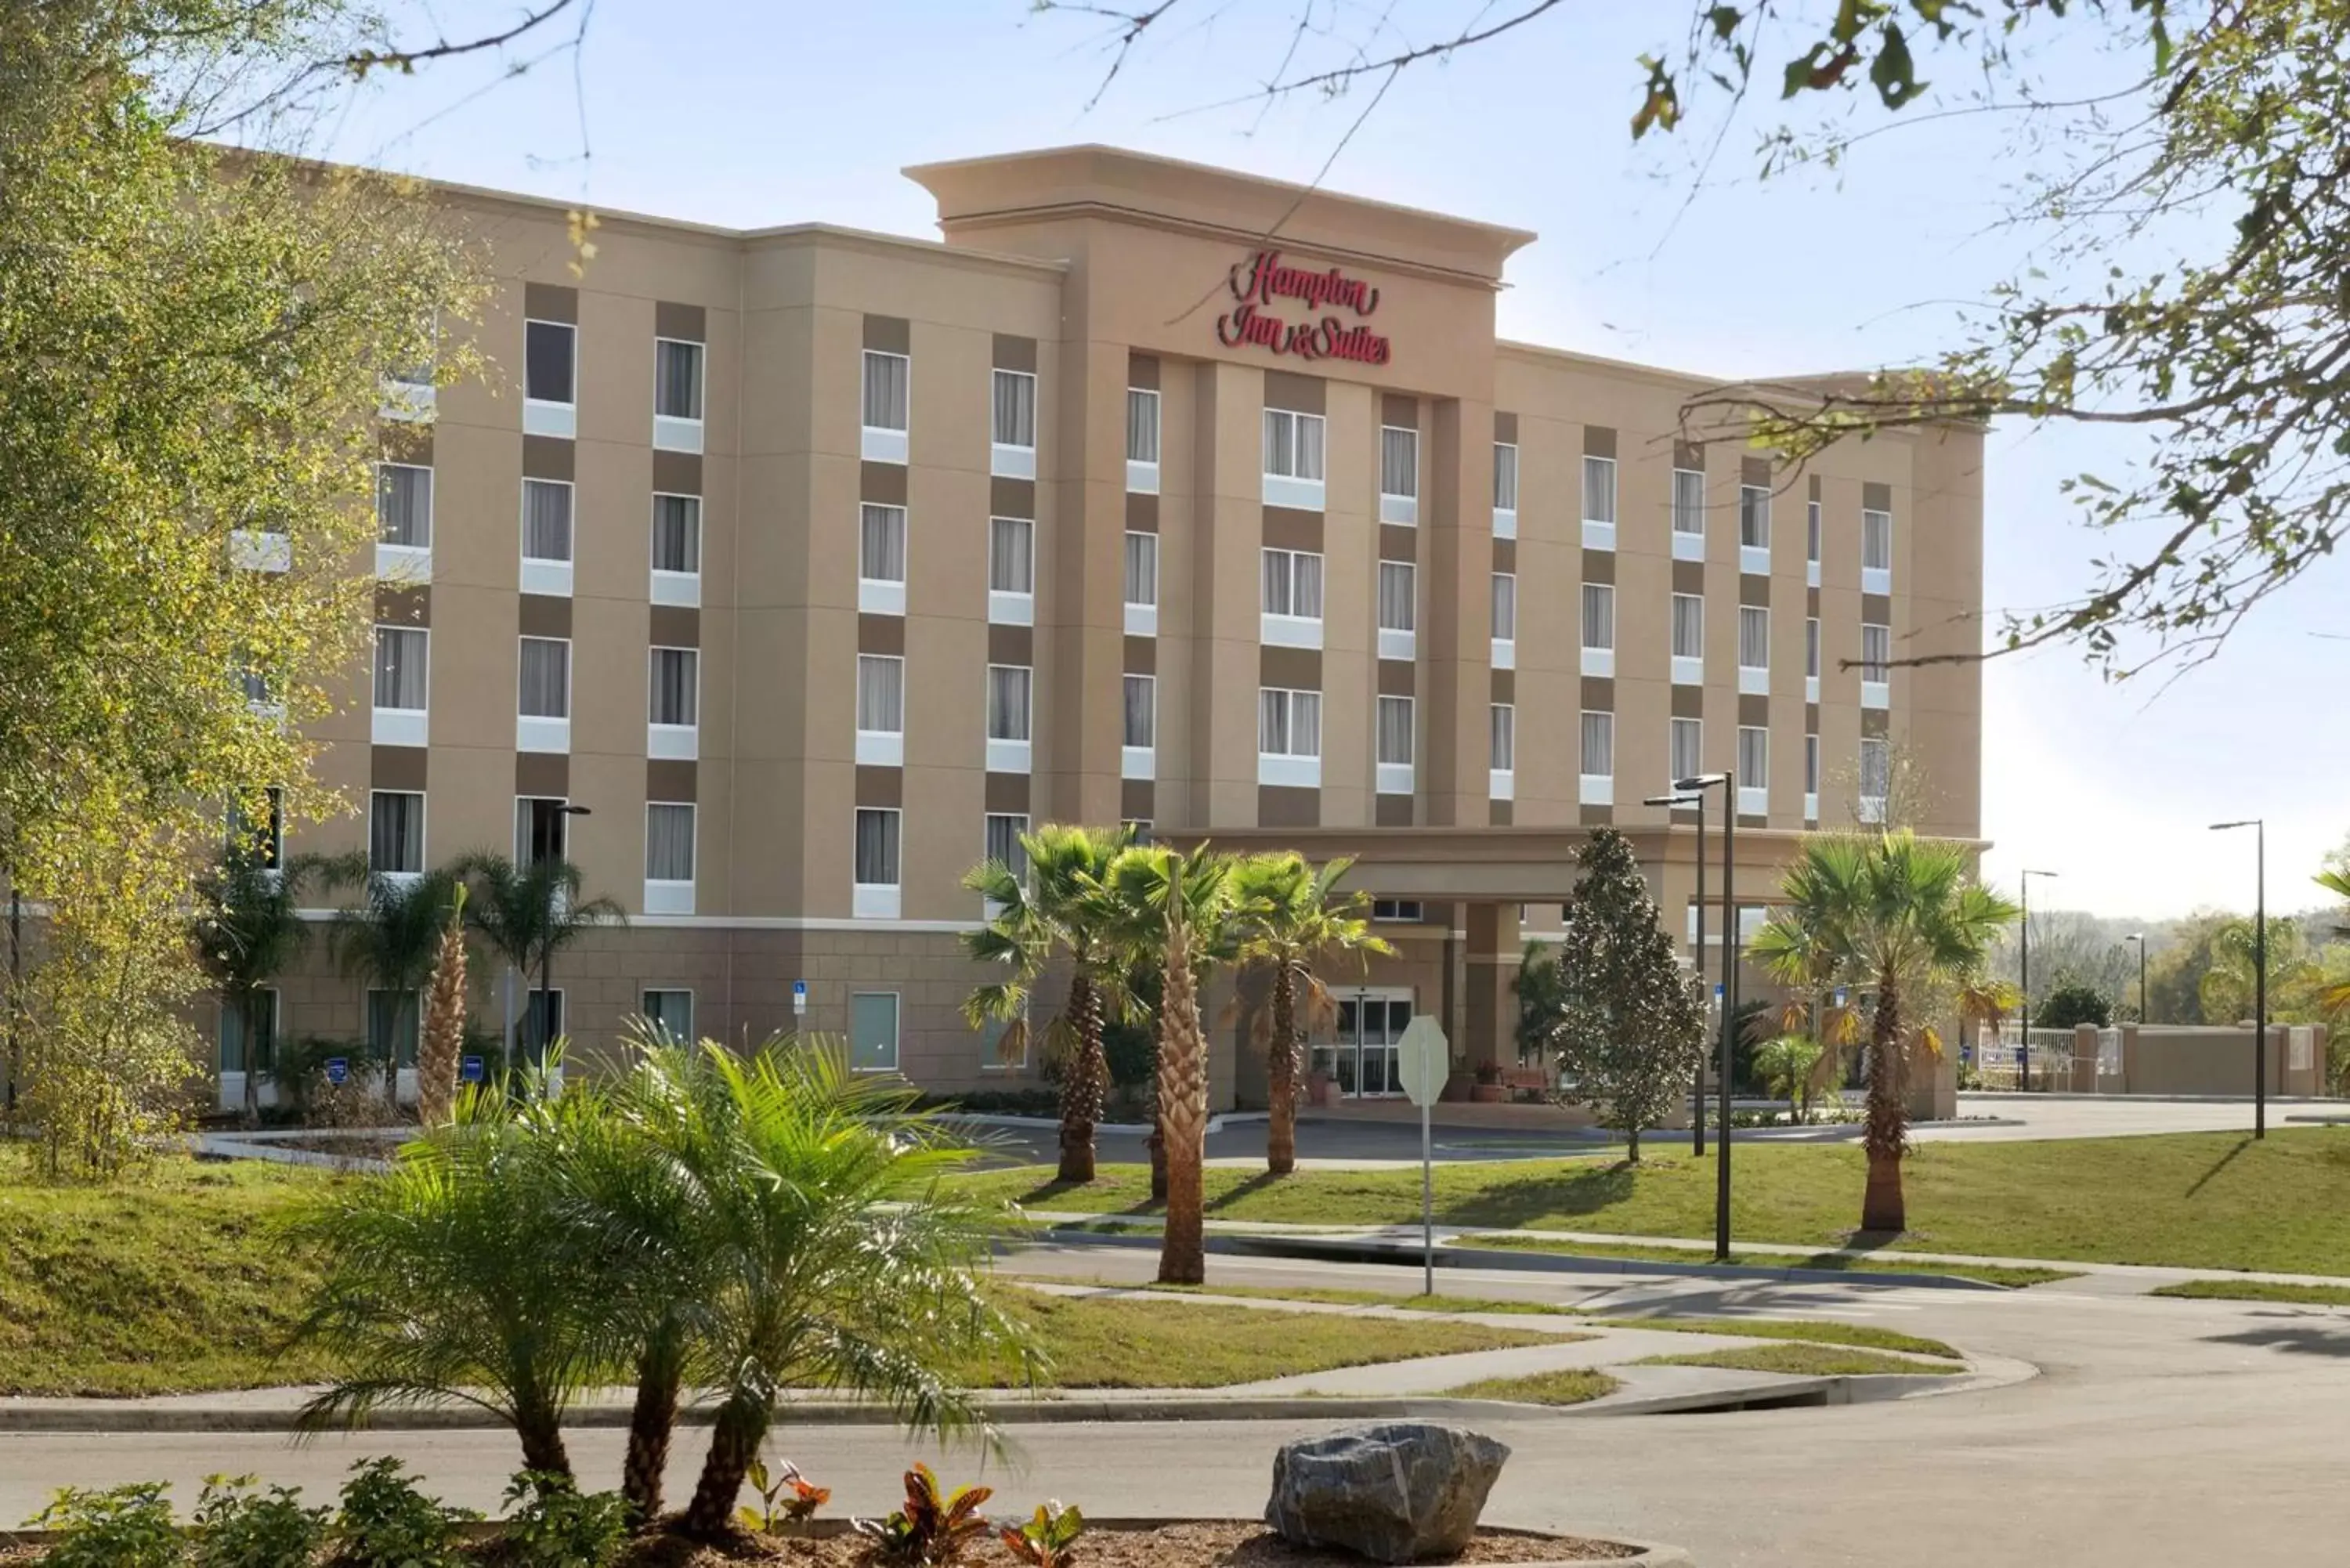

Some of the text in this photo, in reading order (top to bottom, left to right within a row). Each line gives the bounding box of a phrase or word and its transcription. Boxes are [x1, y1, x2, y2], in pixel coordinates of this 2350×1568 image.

[1229, 249, 1379, 316] Hampton
[1217, 305, 1390, 365] Inn & Suites
